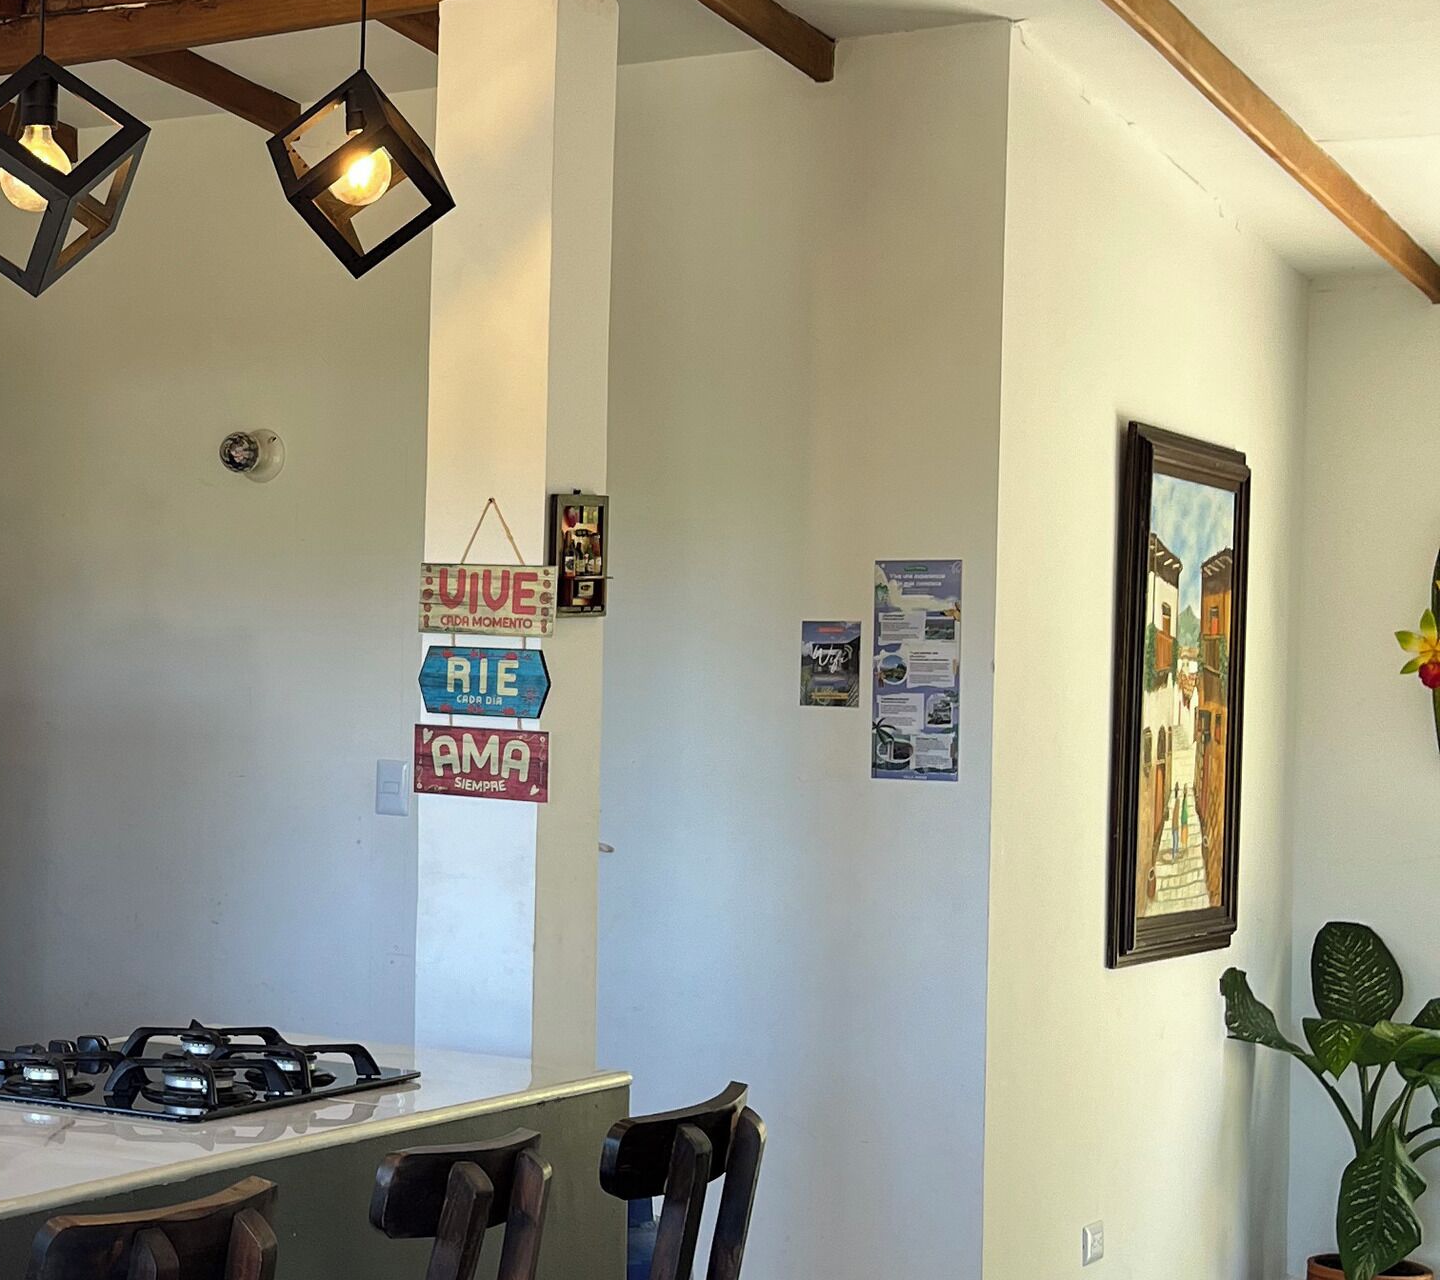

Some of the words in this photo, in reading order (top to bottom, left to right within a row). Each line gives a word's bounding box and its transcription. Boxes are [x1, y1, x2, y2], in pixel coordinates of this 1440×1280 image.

[439, 568, 538, 616] VIVE
[440, 615, 469, 627] CADA
[472, 616, 533, 629] MOMENTO
[446, 656, 519, 696] RIE
[456, 694, 482, 704] CADA
[485, 696, 503, 705] DIA
[431, 733, 531, 783] AMA
[454, 777, 507, 793] SIEMPRE
